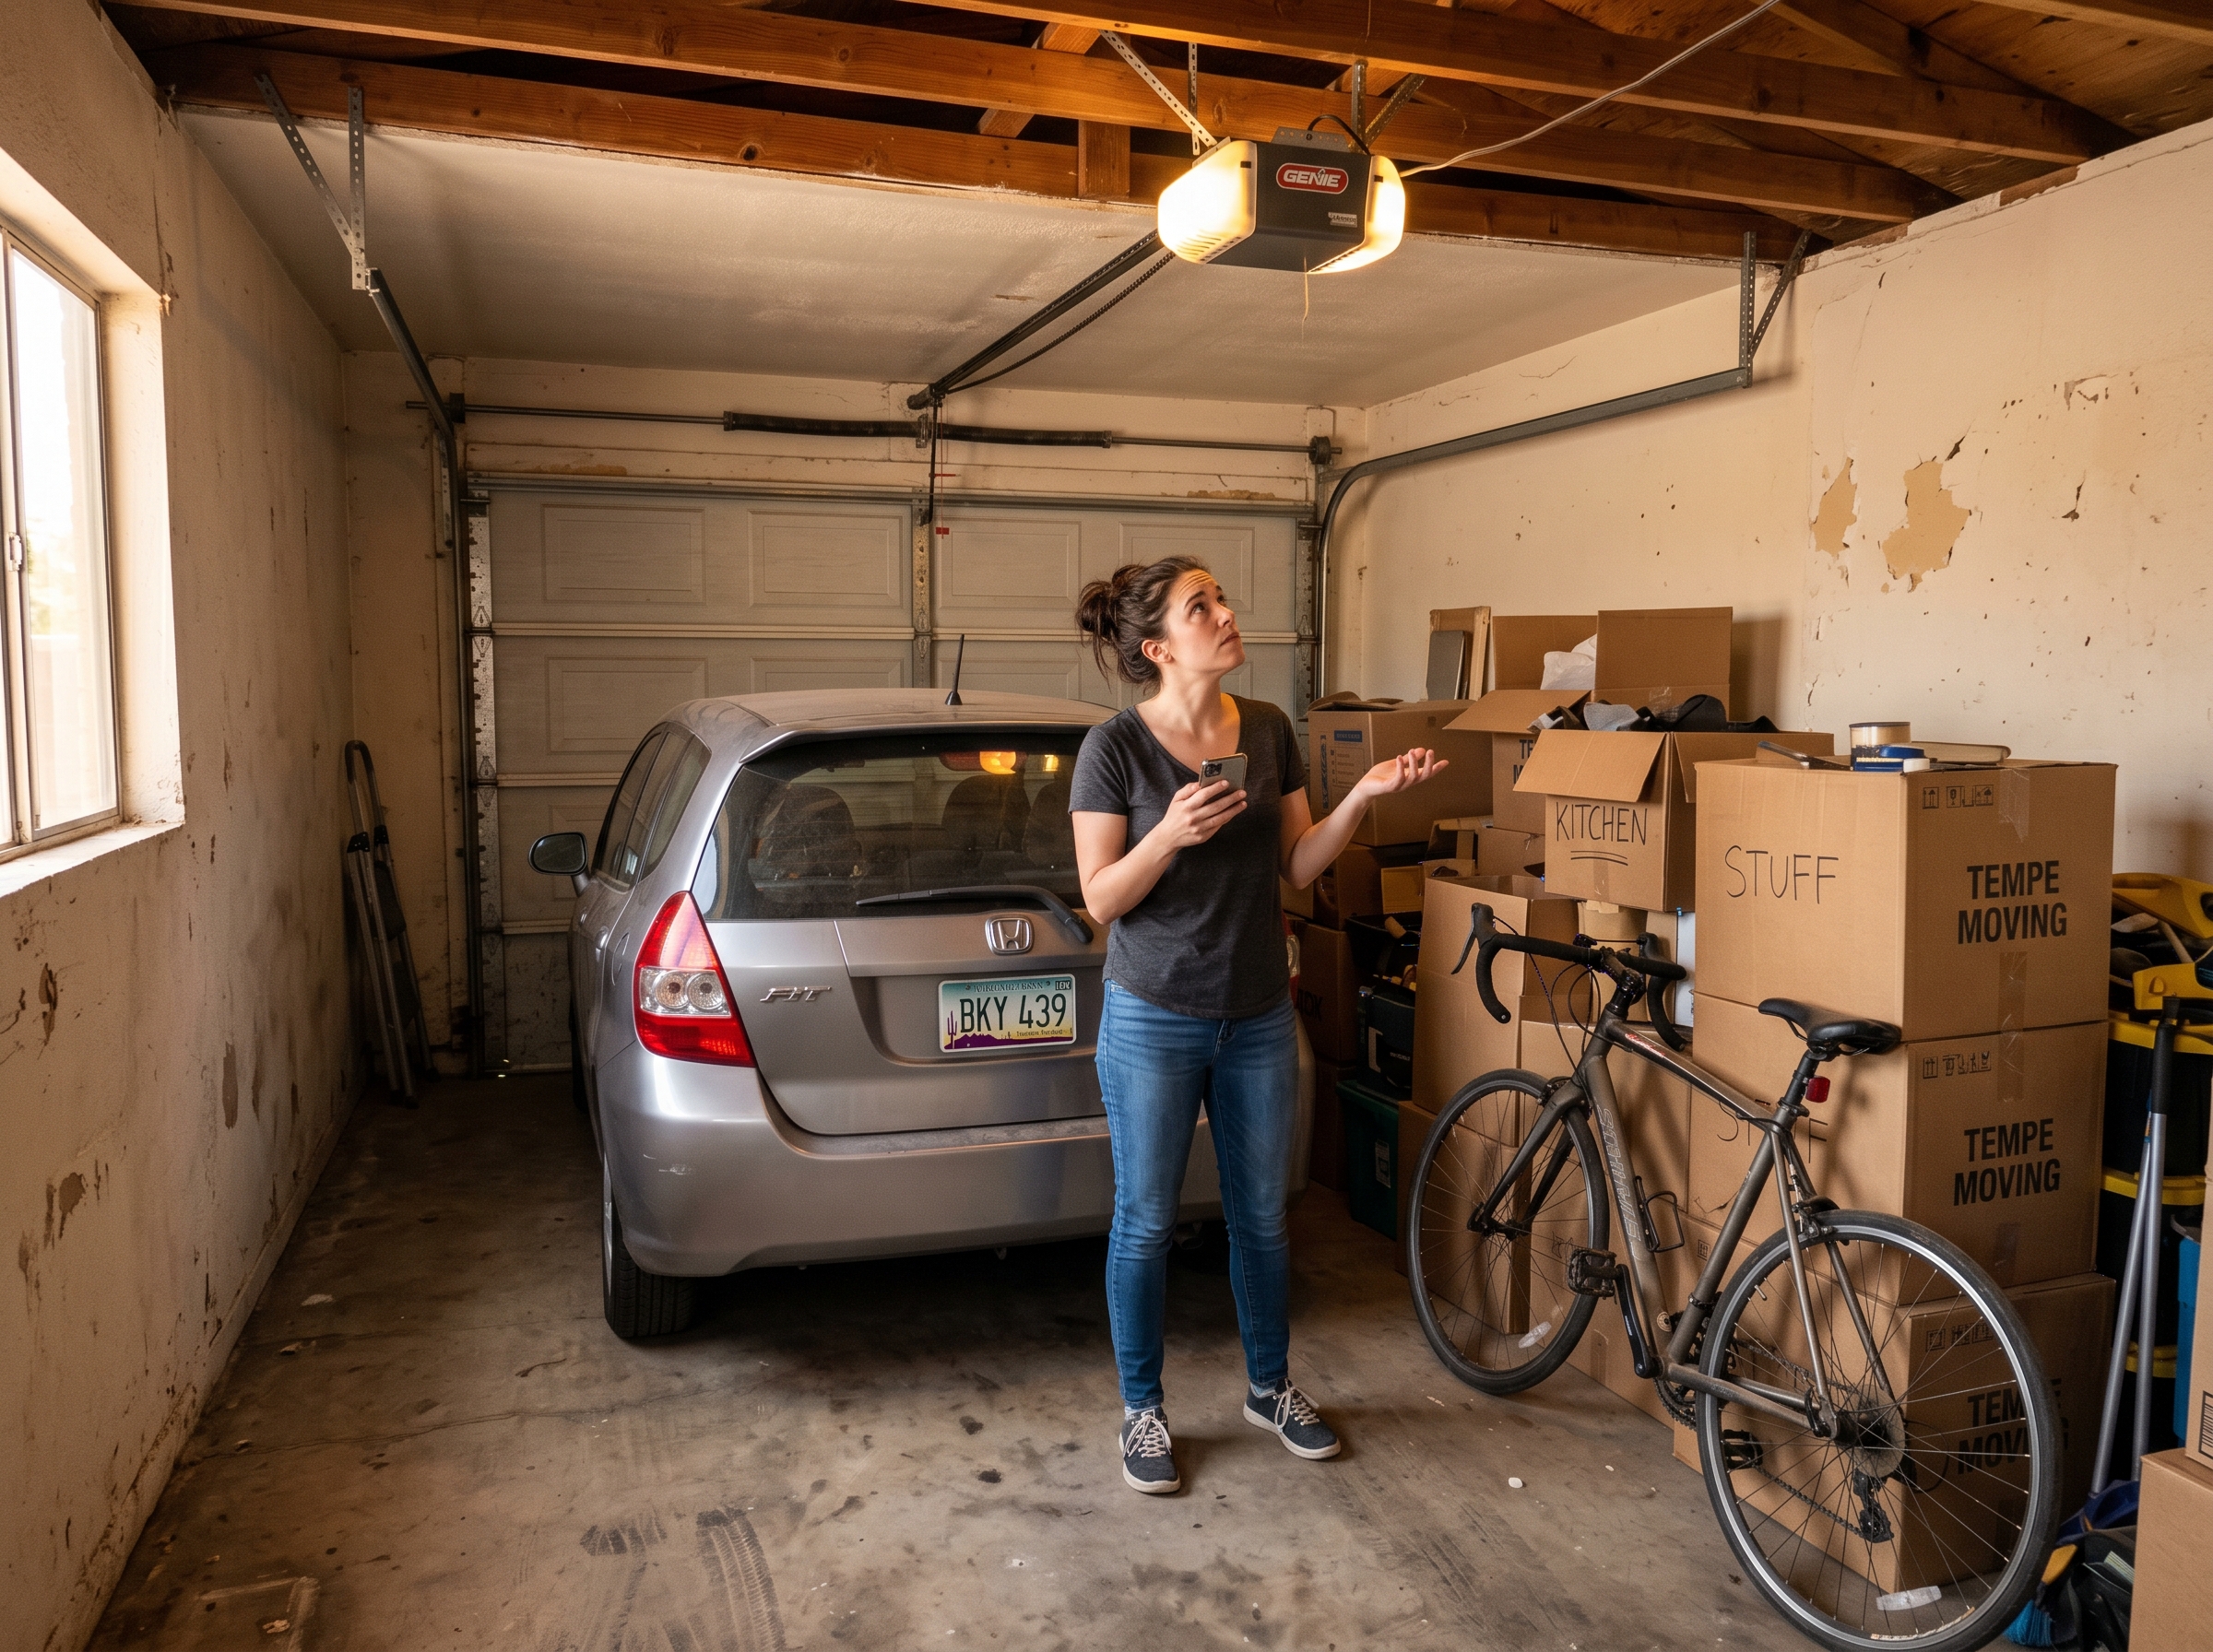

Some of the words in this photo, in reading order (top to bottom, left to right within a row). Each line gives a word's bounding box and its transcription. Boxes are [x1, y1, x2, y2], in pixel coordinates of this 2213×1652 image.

[1283, 169, 1342, 188] GENIE
[1556, 801, 1648, 846] KITCHEN
[1724, 844, 1840, 904] STUFF
[1966, 860, 2060, 900] TEMPE
[1958, 903, 2067, 945] MOVING
[959, 996, 1008, 1033] BKY
[1018, 993, 1068, 1029] 439
[1963, 1117, 2054, 1162] TEMPE
[1953, 1158, 2062, 1207] MOVING
